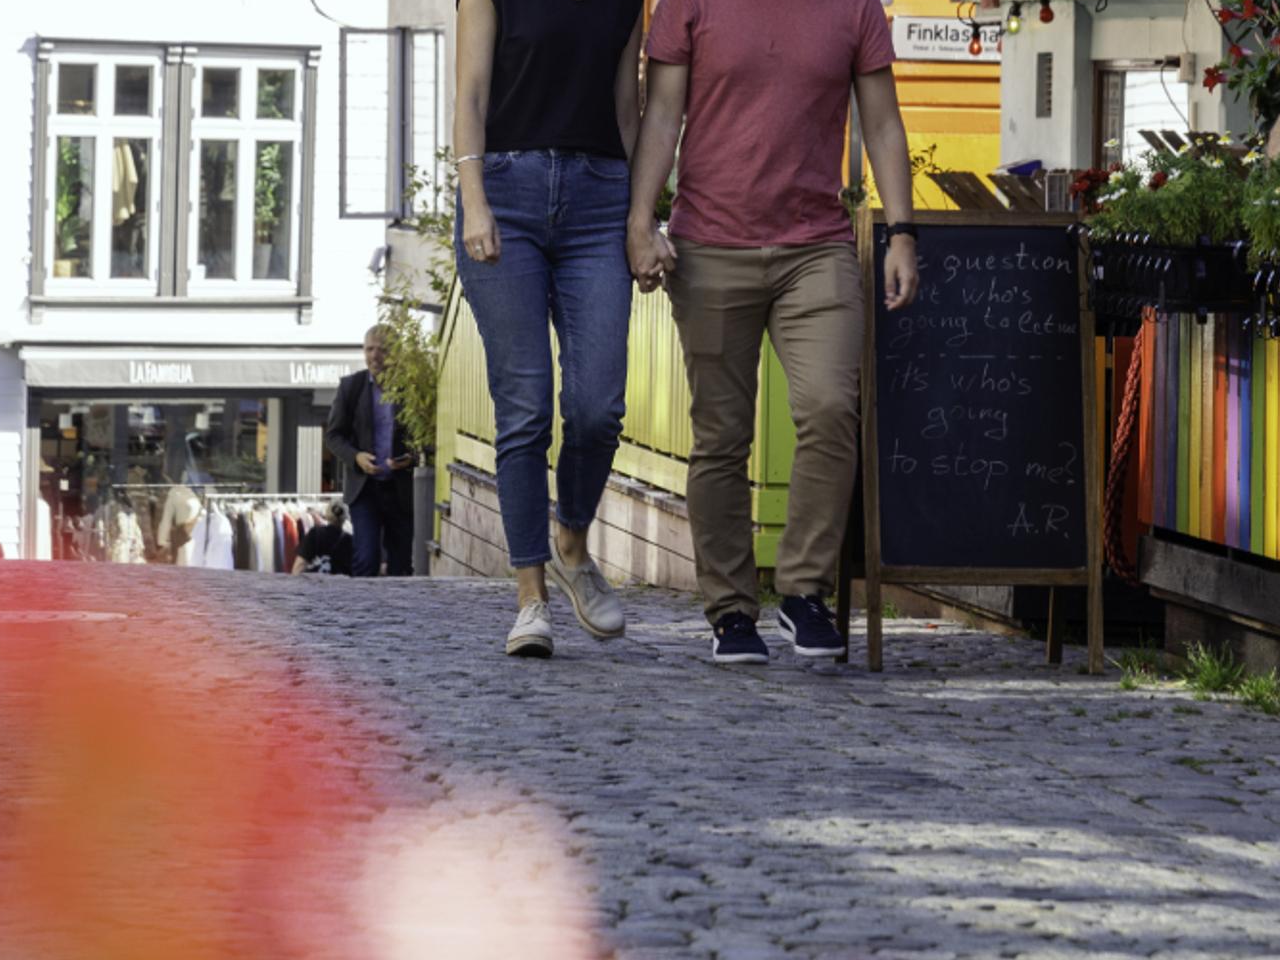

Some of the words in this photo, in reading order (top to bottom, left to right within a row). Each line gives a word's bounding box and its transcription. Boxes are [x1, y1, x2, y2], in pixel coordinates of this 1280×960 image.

[943, 241, 1073, 283] question
[961, 275, 1033, 305] who's
[889, 313, 973, 348] going
[984, 306, 1010, 329] to
[1018, 310, 1057, 336] let
[891, 361, 929, 392] it's
[950, 362, 1033, 395] who's
[921, 404, 1009, 440] going
[889, 438, 918, 474] to
[931, 441, 1009, 490] stop
